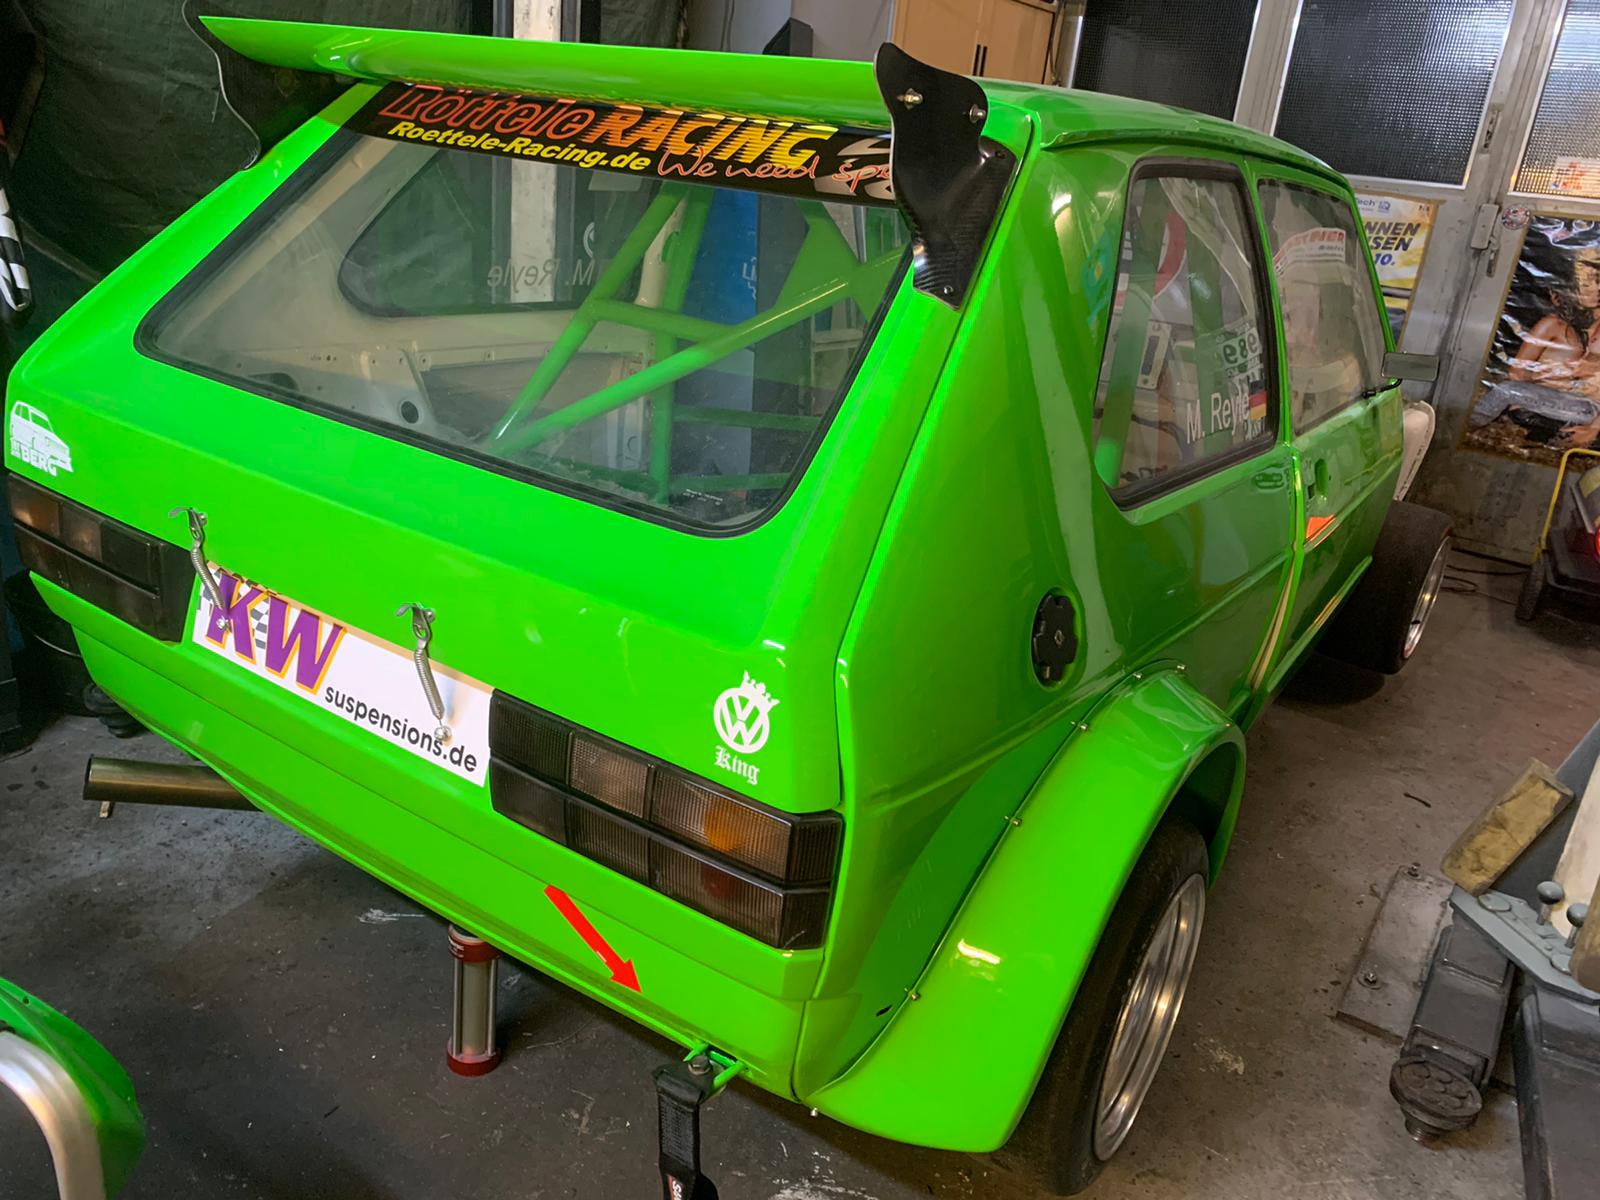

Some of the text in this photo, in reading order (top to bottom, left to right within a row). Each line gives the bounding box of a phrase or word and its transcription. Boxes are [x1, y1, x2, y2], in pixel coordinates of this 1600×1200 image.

[387, 120, 651, 169] Roettele-Racing.de
[577, 104, 839, 169] RACING
[657, 145, 890, 193] We need spe
[1368, 236, 1413, 252] SEN
[1186, 399, 1206, 445] M.
[1210, 391, 1250, 436] Reyle
[205, 571, 348, 695] KW
[323, 685, 478, 773] suspensions.de
[713, 745, 760, 785] King
